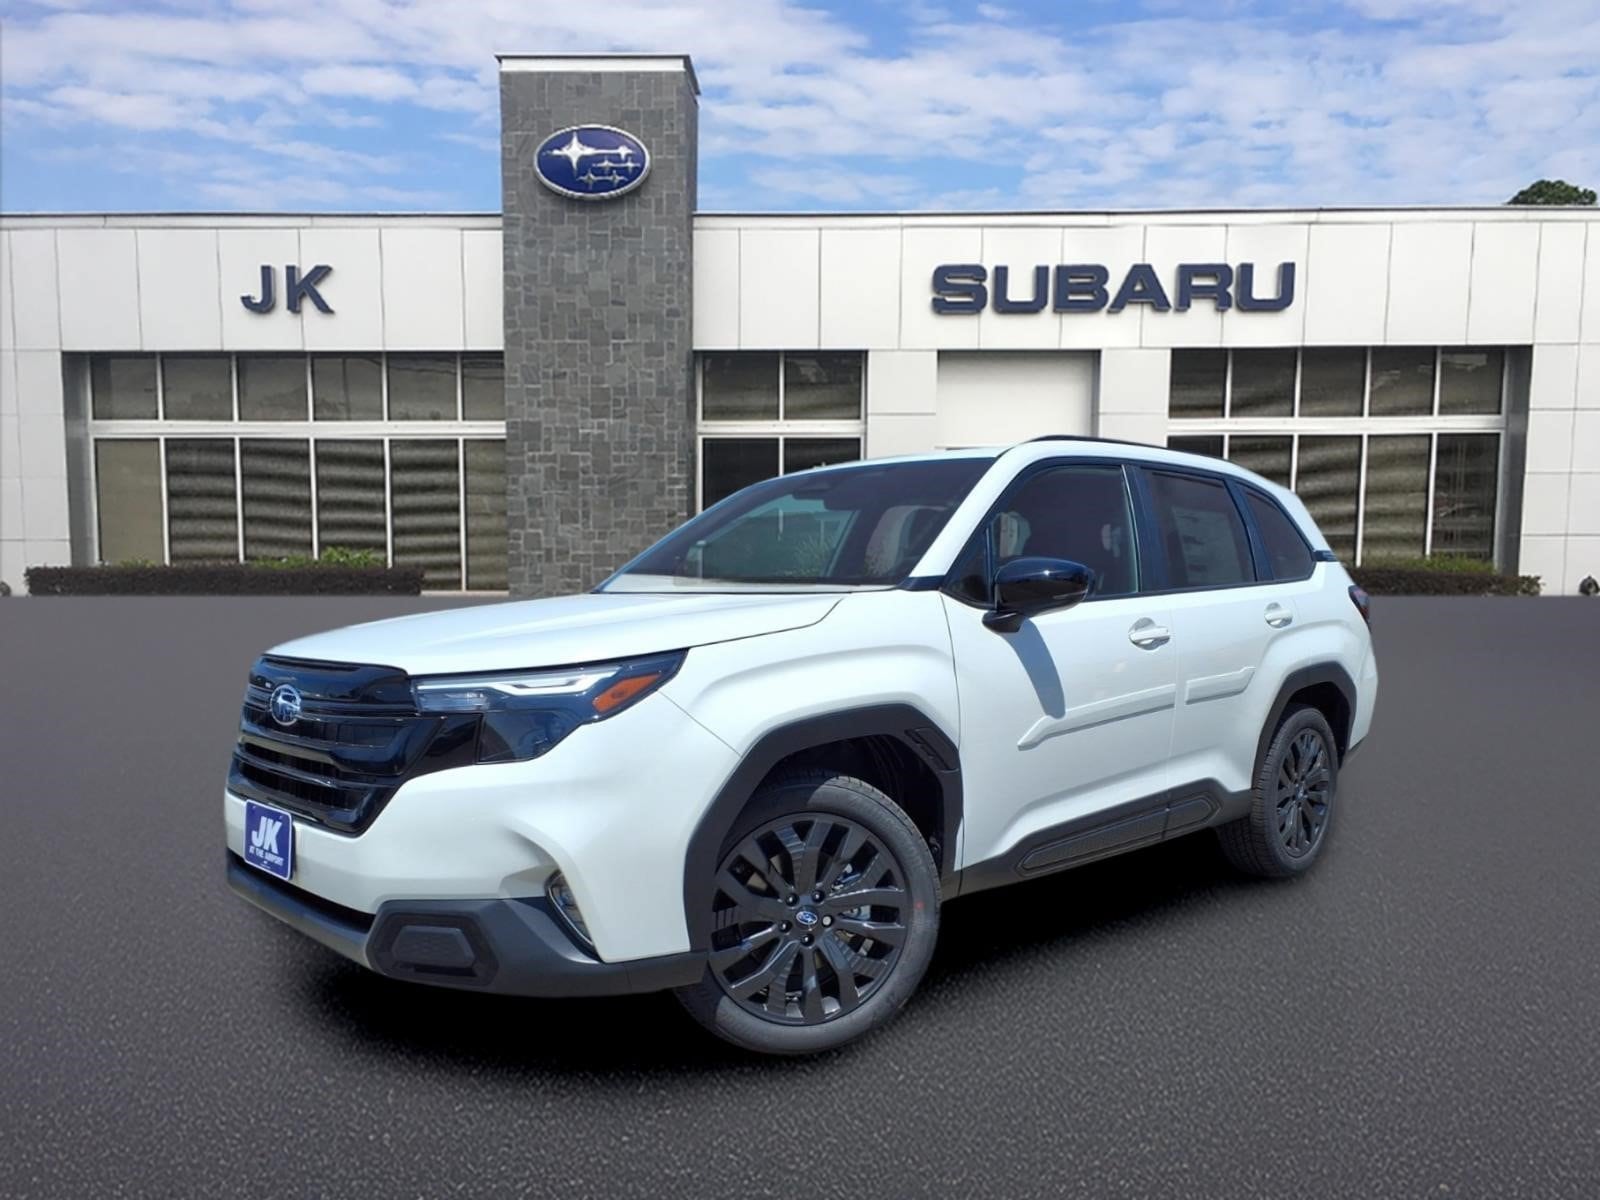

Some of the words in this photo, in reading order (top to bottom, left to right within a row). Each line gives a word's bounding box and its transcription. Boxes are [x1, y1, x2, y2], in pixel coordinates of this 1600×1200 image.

[240, 264, 335, 314] JK
[931, 262, 1296, 315] SUBARU
[251, 815, 283, 854] JK
